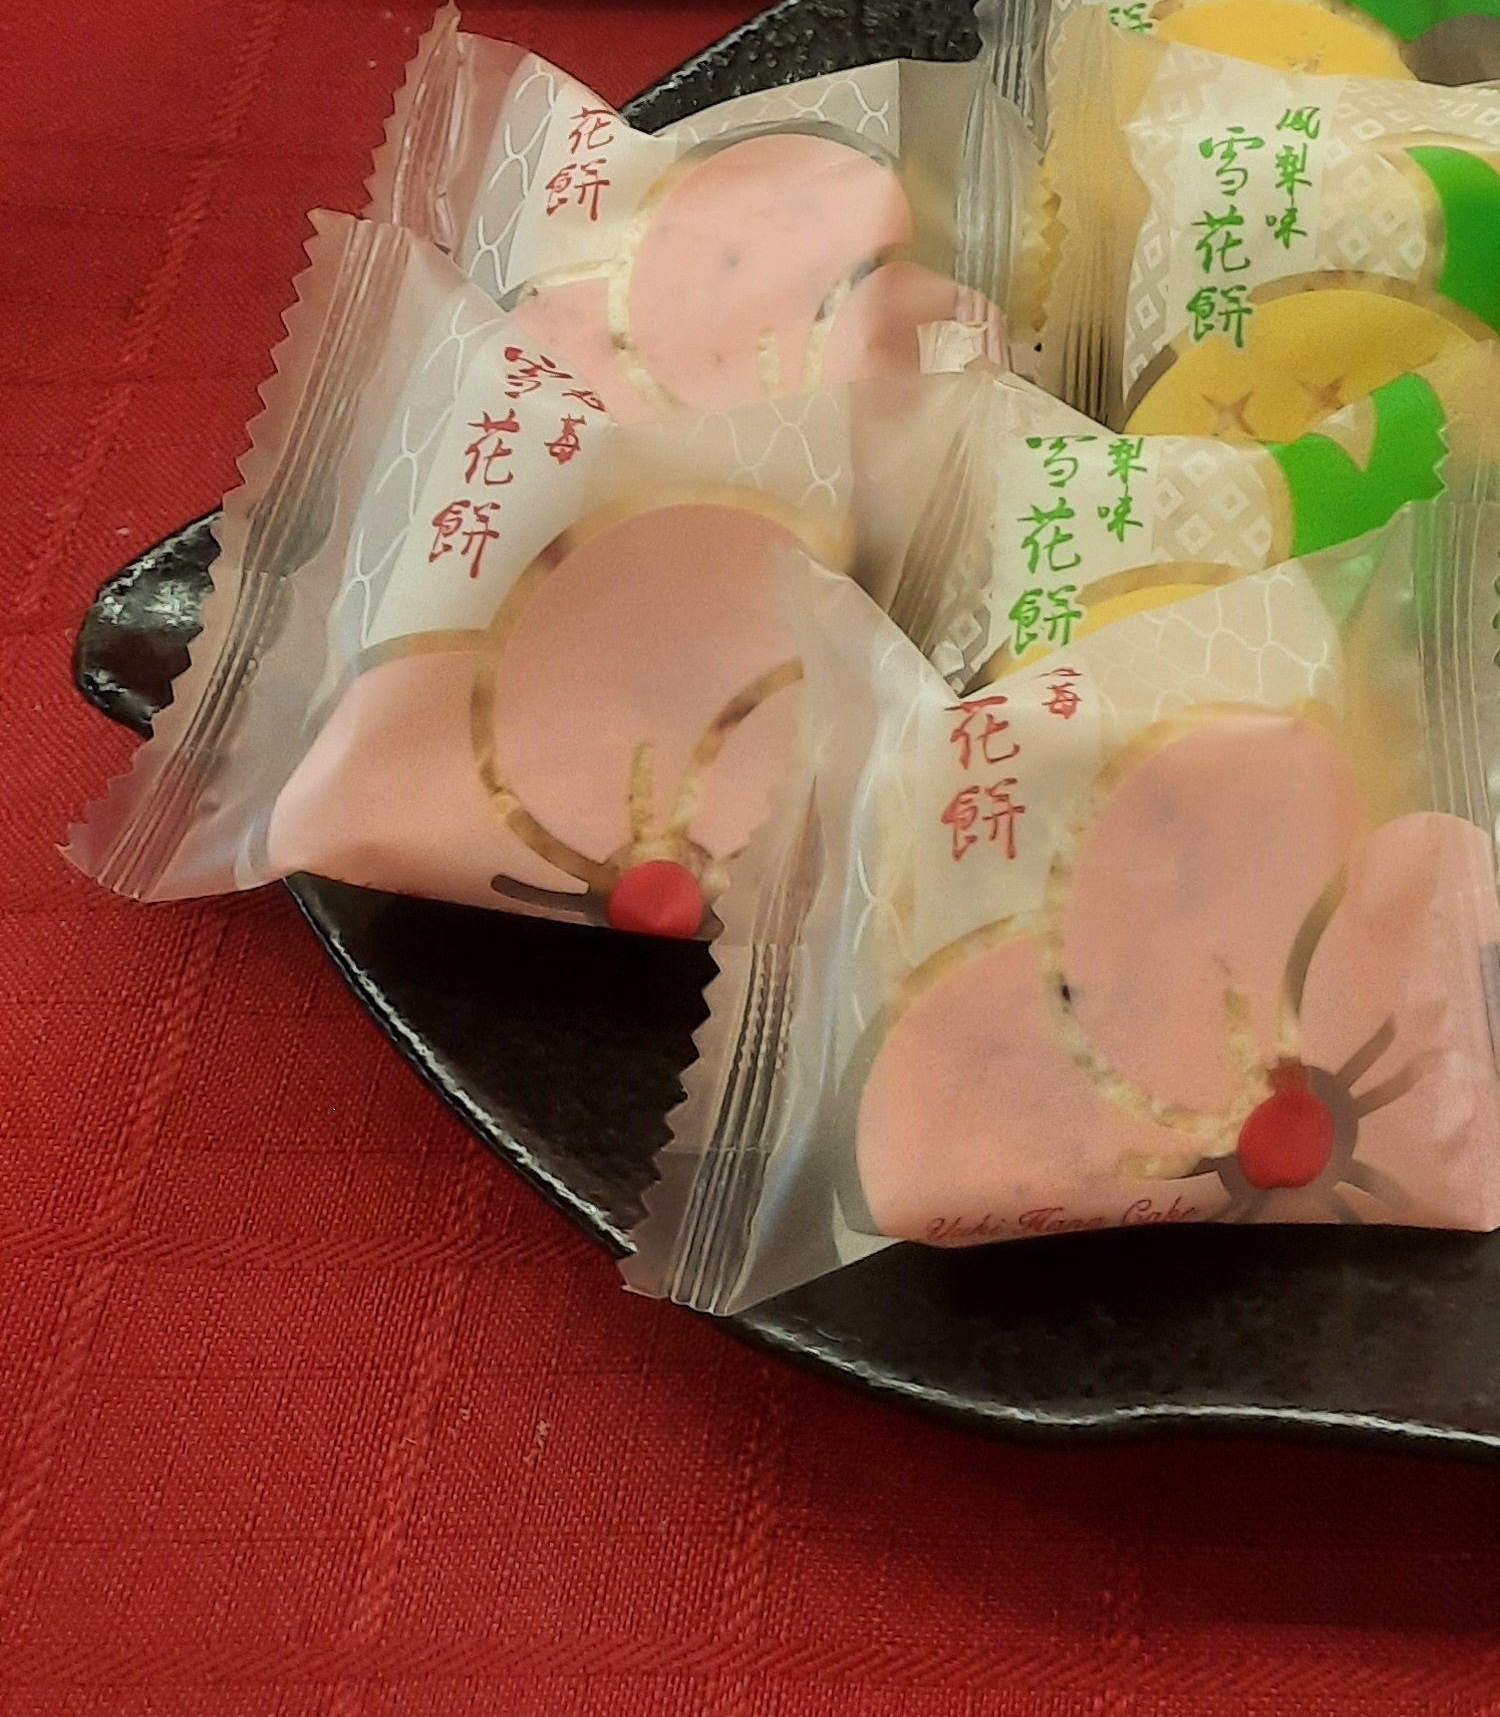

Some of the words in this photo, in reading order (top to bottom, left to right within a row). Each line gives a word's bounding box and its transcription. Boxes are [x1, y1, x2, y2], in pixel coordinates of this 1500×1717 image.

[544, 107, 613, 222] 花餅
[1186, 125, 1265, 348] 雪花餅
[428, 346, 573, 579] 雪花餅
[1008, 435, 1098, 655] 雪花餅
[1036, 666, 1084, 720] 莓
[940, 695, 1026, 861] 花餅
[926, 1212, 1006, 1241] Yuki
[1018, 1205, 1106, 1234] Hana
[1122, 1195, 1197, 1225] Cake
